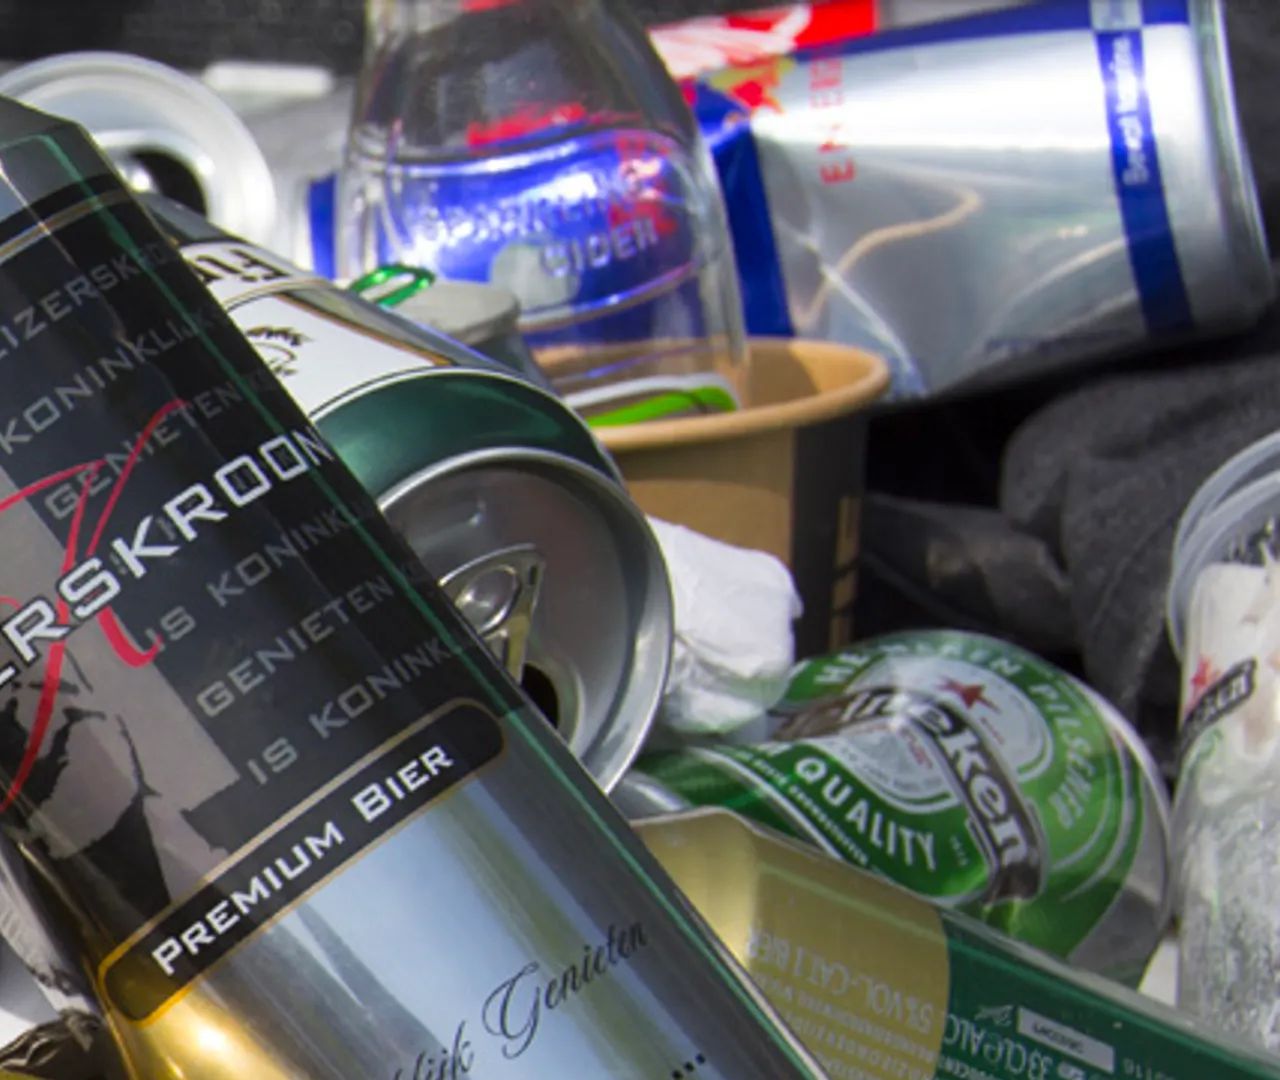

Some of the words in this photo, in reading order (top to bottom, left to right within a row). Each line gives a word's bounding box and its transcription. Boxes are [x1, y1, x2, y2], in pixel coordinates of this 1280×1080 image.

[206, 497, 385, 608] KONINK
[195, 564, 406, 721] GENIETEN
[247, 734, 301, 786] IS
[309, 632, 452, 740] KONINK
[150, 819, 347, 977] PREMIUM
[351, 742, 456, 825] BIER
[793, 752, 937, 873] QUALITY
[482, 918, 651, 1060] Genieten
